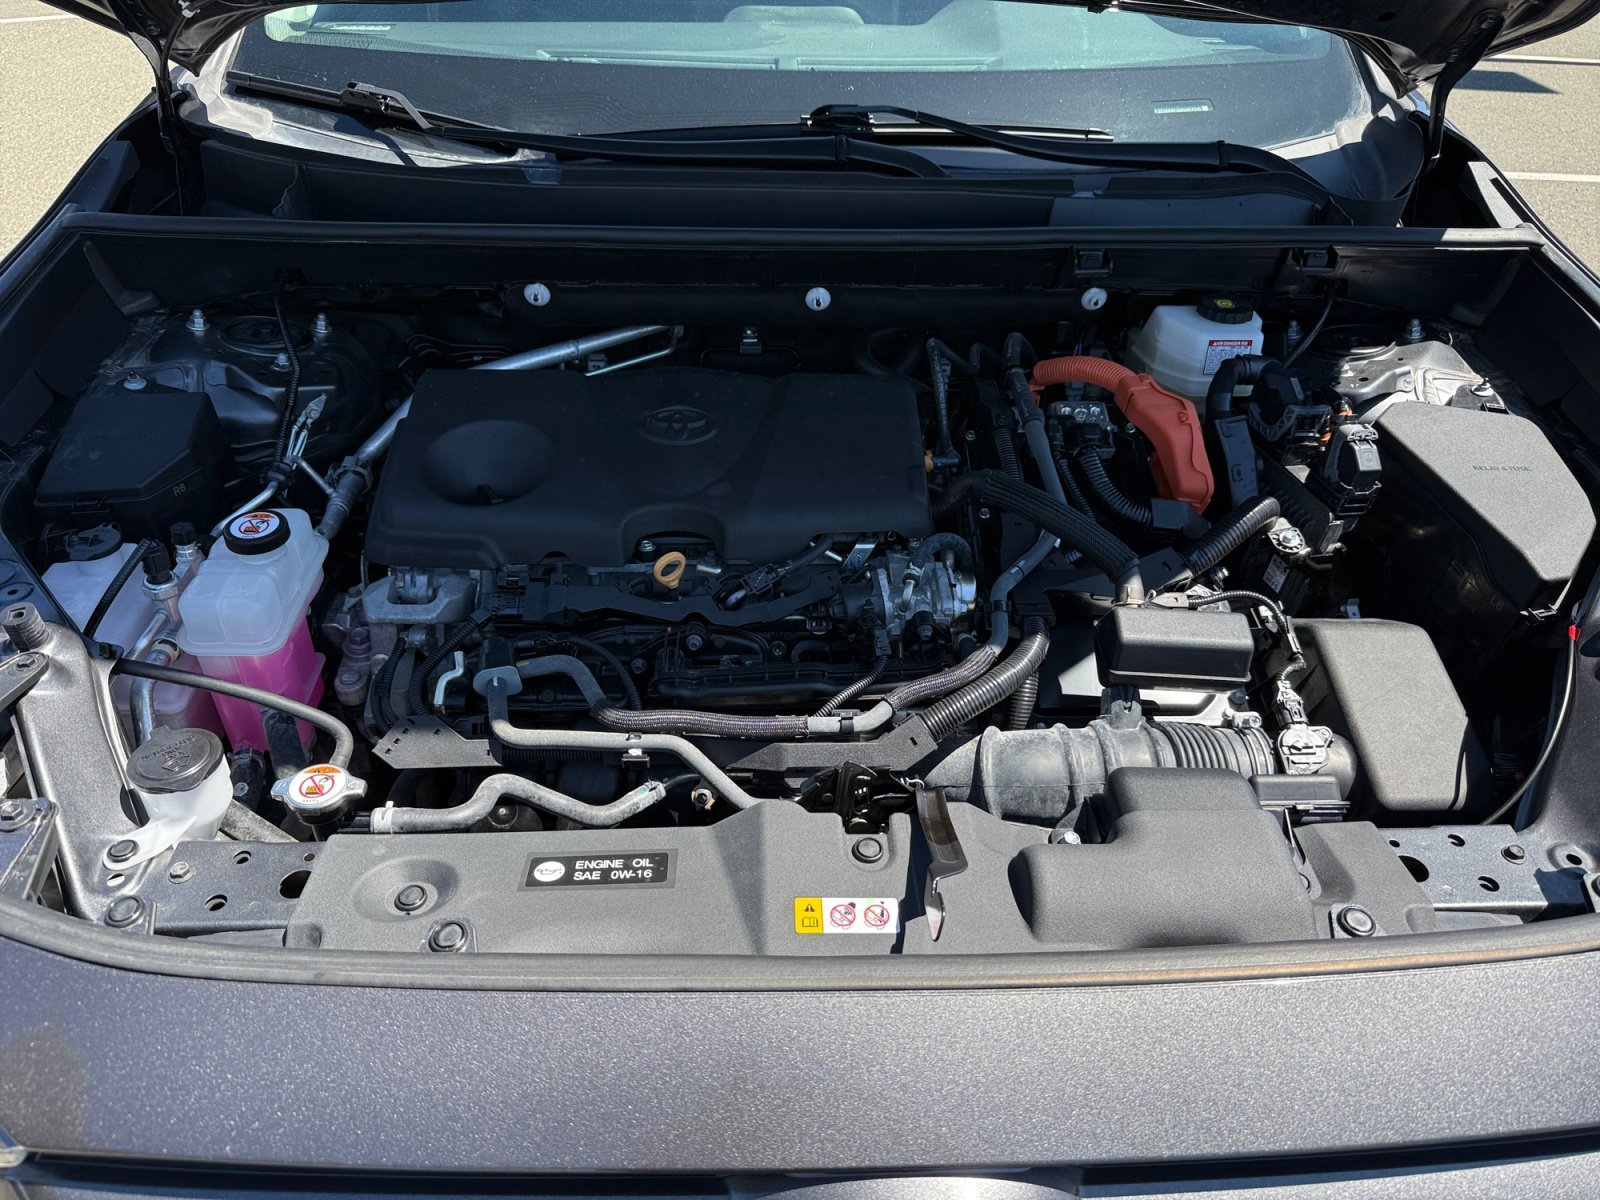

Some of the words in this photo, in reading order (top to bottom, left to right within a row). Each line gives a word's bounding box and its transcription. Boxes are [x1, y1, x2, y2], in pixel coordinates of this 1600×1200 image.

[172, 483, 186, 497] R6
[575, 859, 624, 870] ENGINE
[632, 858, 654, 868] OIL
[573, 871, 601, 881] SAE
[610, 869, 653, 880] 0W-16
